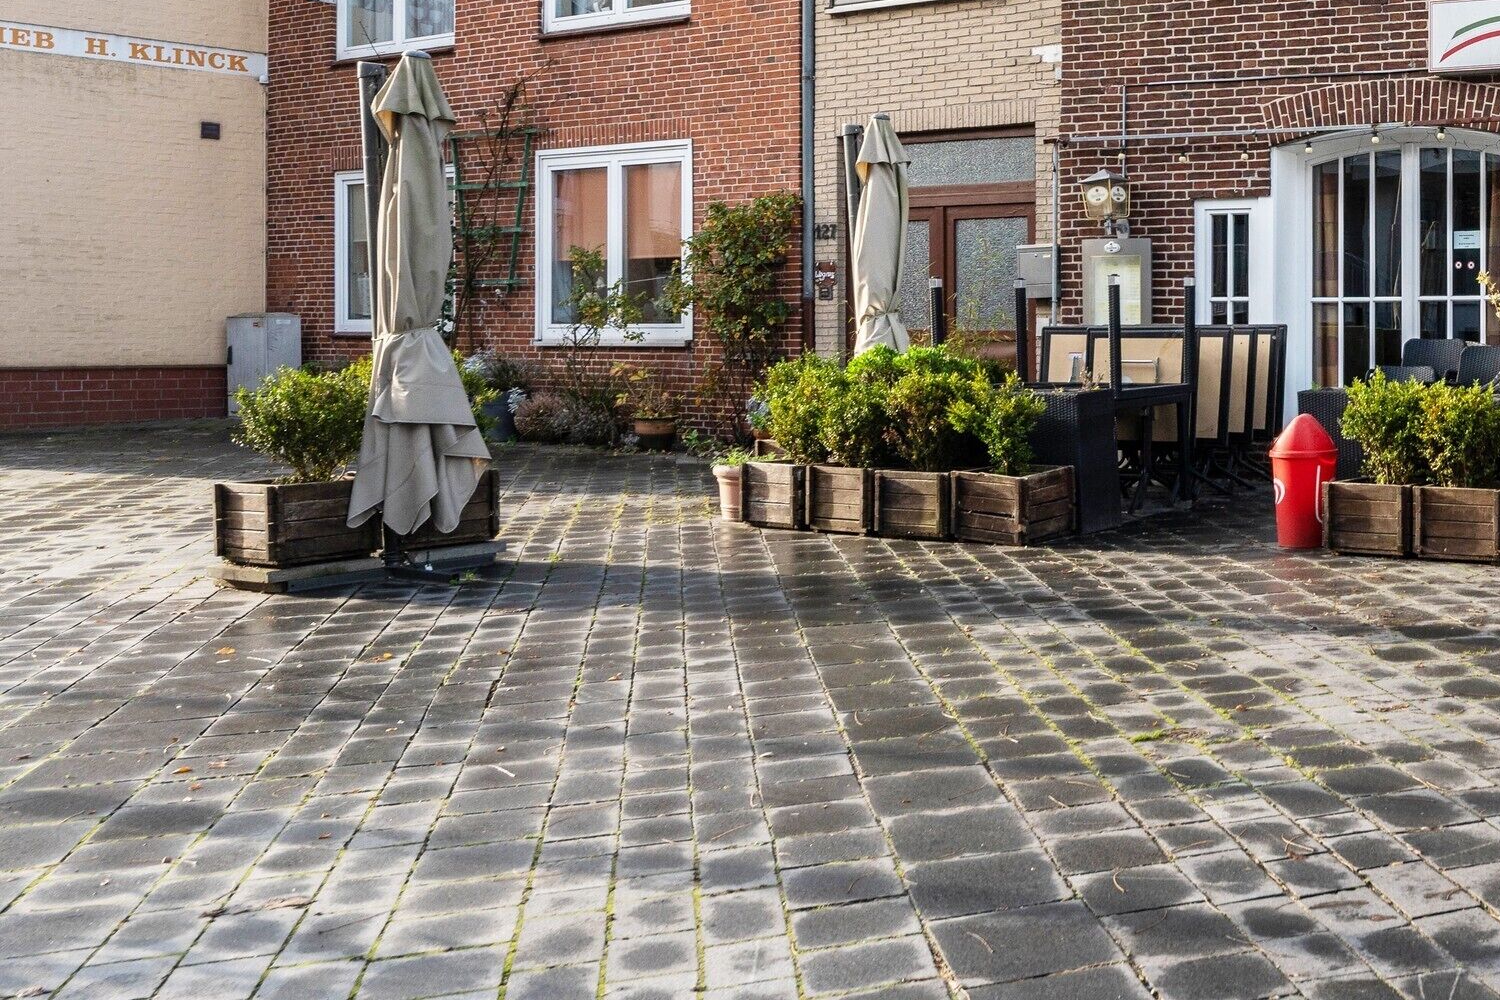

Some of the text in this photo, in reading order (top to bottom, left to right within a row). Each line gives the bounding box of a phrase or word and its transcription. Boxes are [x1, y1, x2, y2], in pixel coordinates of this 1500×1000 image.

[85, 37, 117, 57] H.
[129, 42, 248, 72] KLINCK
[816, 224, 836, 239] 127
